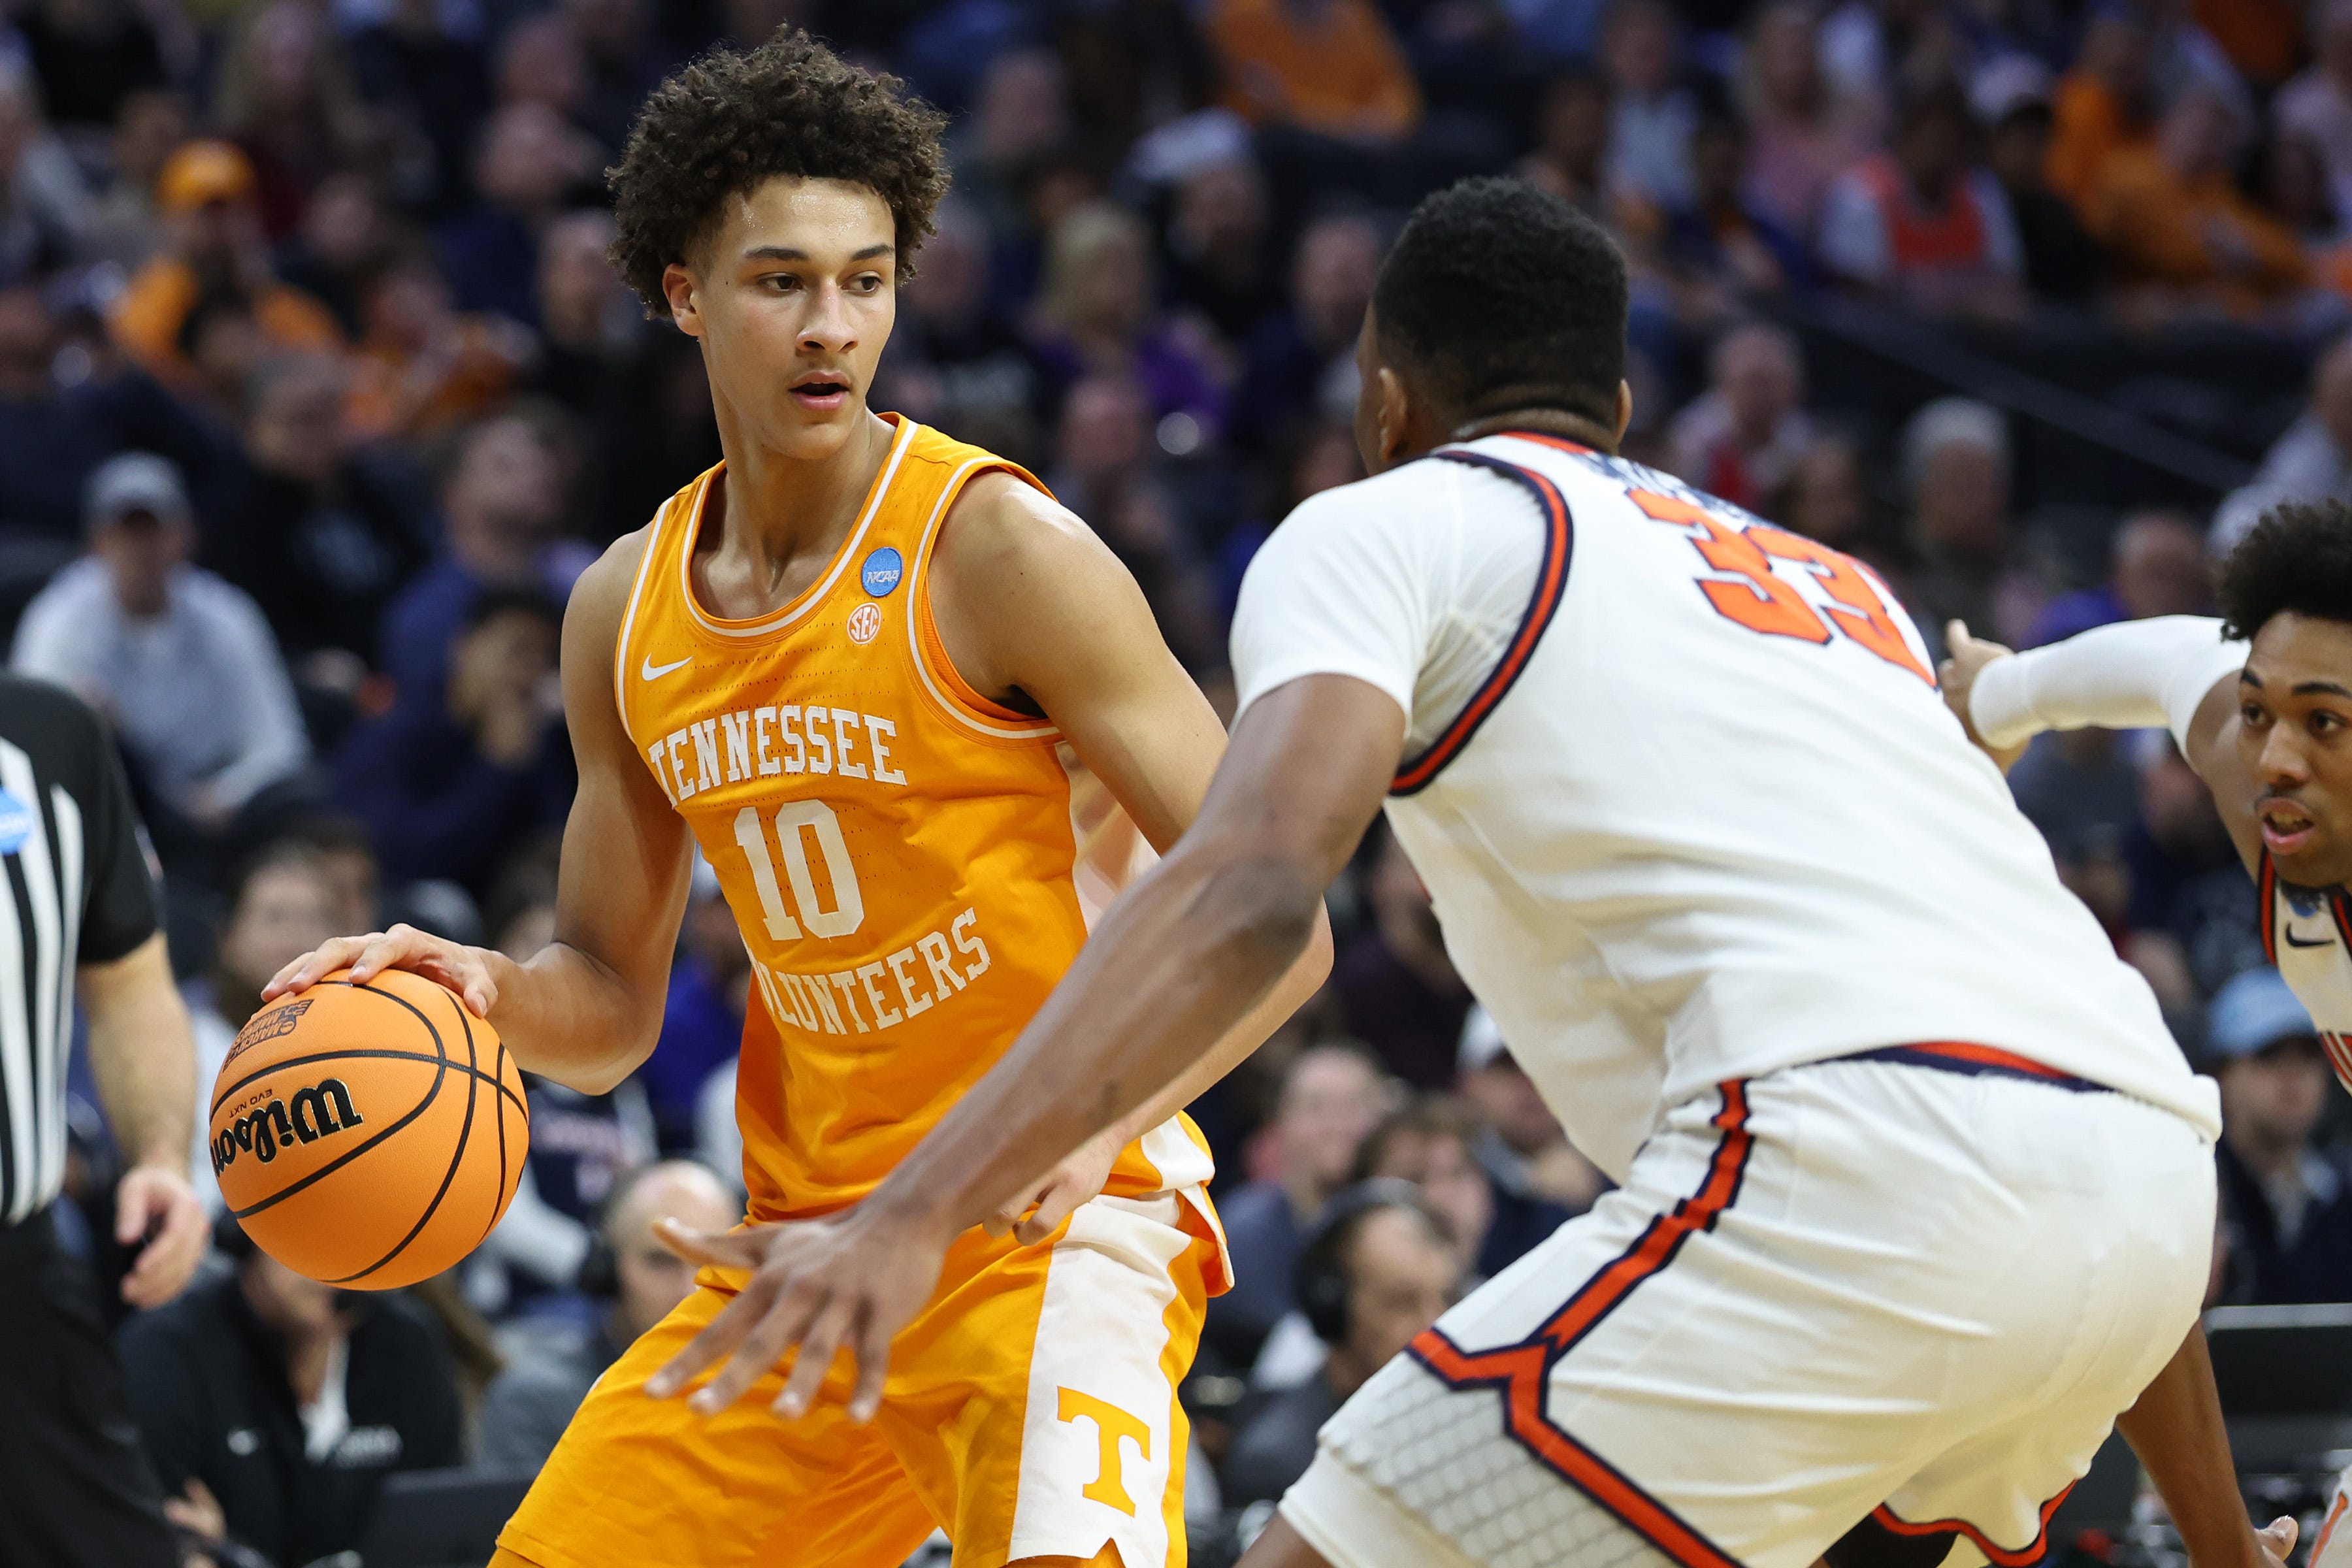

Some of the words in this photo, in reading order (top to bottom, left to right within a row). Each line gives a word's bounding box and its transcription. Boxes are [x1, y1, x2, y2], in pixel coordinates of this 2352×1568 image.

[850, 606, 879, 641] SEC
[866, 569, 900, 583] NCAA
[1625, 485, 1940, 694] 33
[647, 704, 908, 810] TENNESSEE
[733, 798, 866, 941] 10
[739, 907, 992, 1036] OLUNTEERS
[210, 1077, 364, 1179] Wilson
[229, 1100, 248, 1119] NXT
[250, 1088, 273, 1105] EVO
[1056, 1384, 1151, 1519] T
